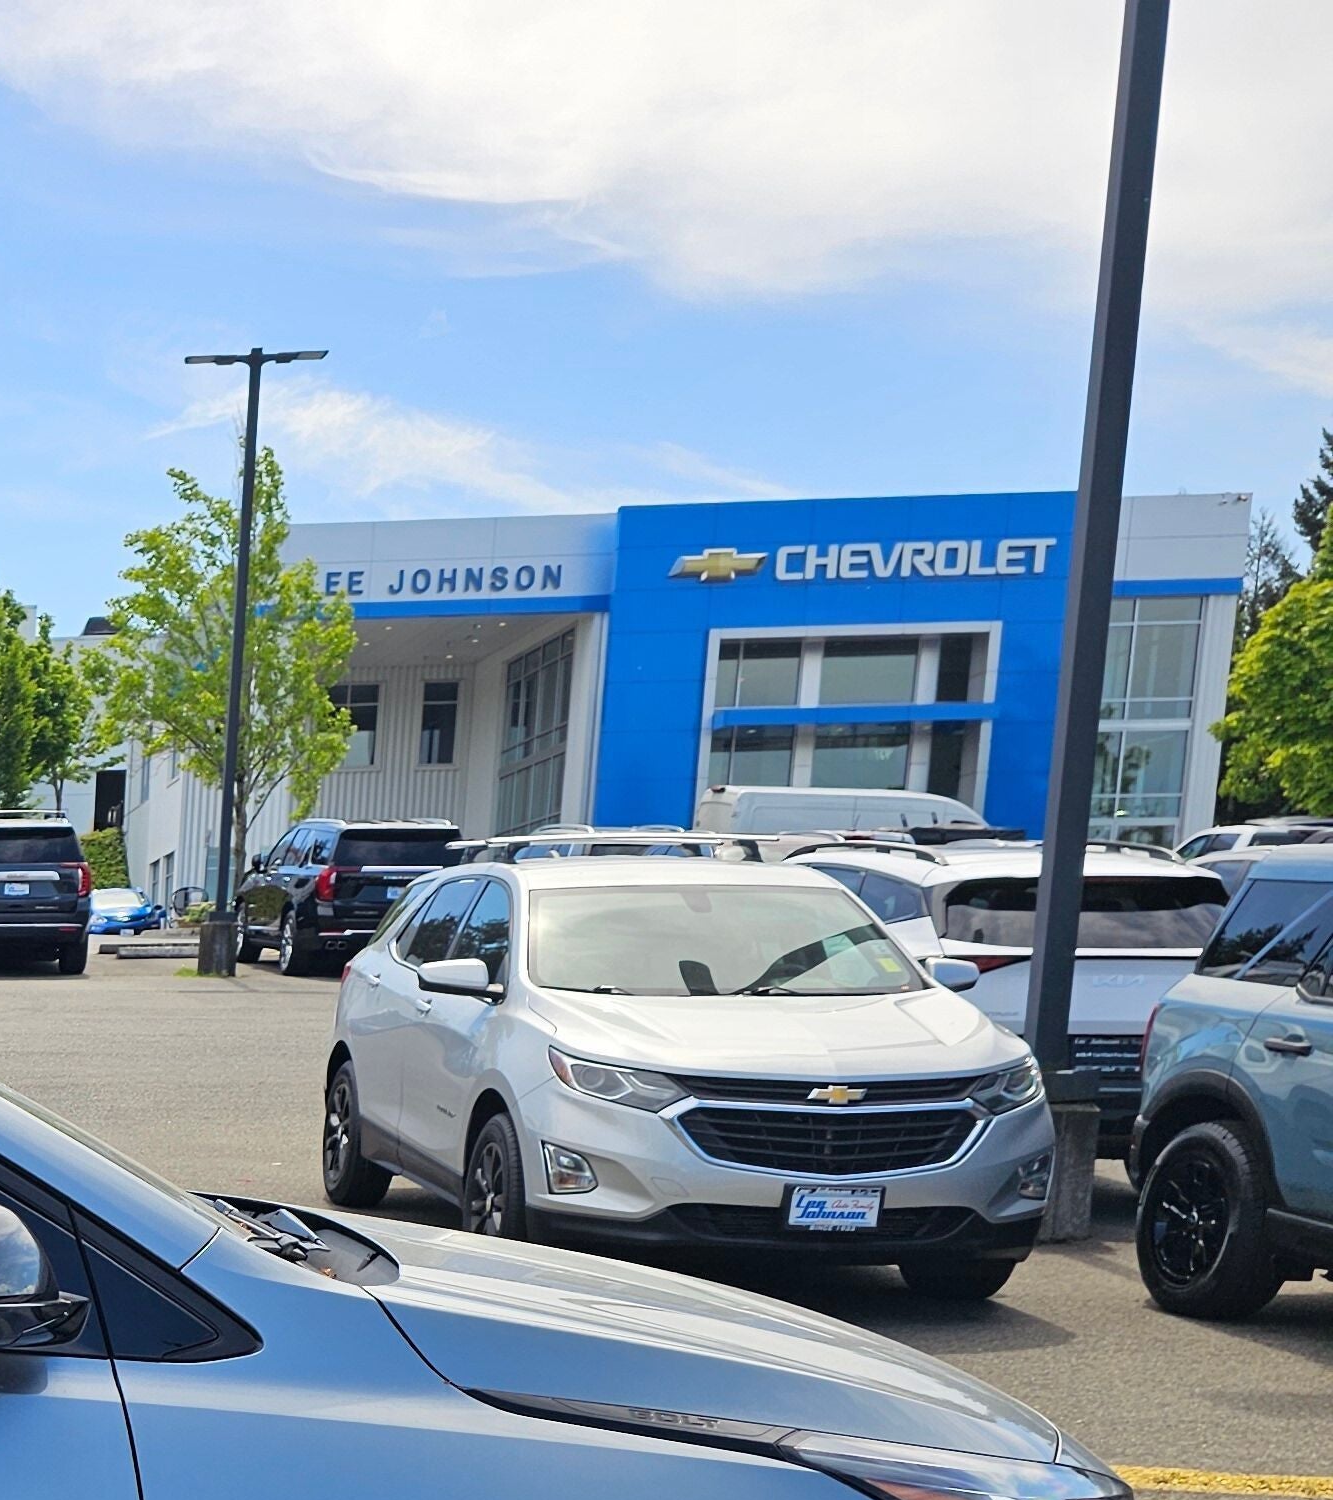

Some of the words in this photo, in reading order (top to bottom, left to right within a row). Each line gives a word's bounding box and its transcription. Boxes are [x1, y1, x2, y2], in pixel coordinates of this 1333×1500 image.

[776, 538, 1058, 581] CHEVROLET
[324, 570, 365, 596] EE
[388, 564, 563, 595] JOHNSON
[796, 1195, 827, 1208] Lee
[796, 1207, 867, 1219] Johnson
[628, 1408, 721, 1430] BOLT
